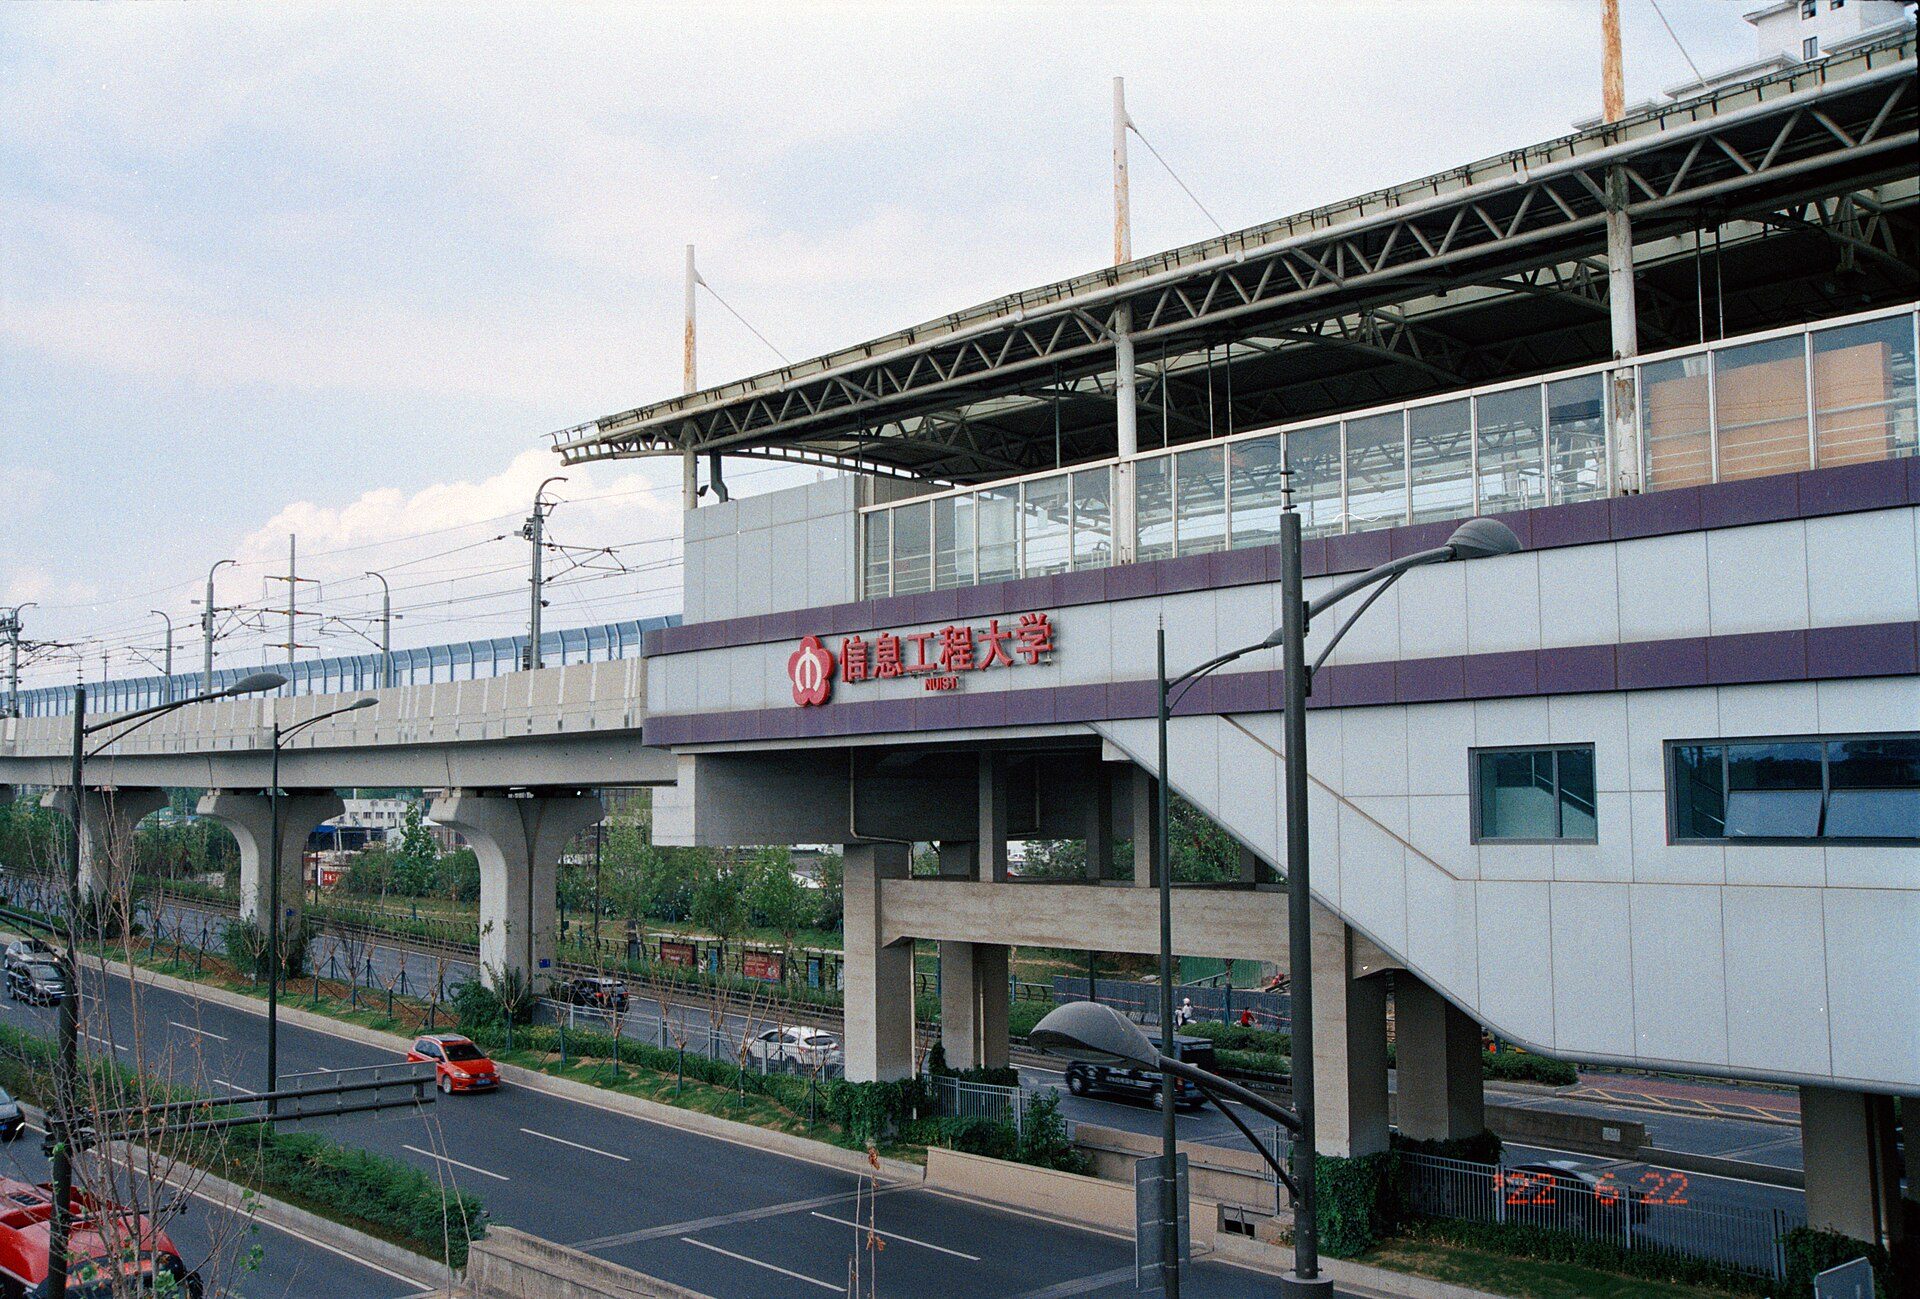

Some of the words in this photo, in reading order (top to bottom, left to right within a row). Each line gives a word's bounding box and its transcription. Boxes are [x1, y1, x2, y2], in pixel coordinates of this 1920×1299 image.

[839, 612, 1054, 683] 信息工程大学
[925, 676, 959, 691] NUIST
